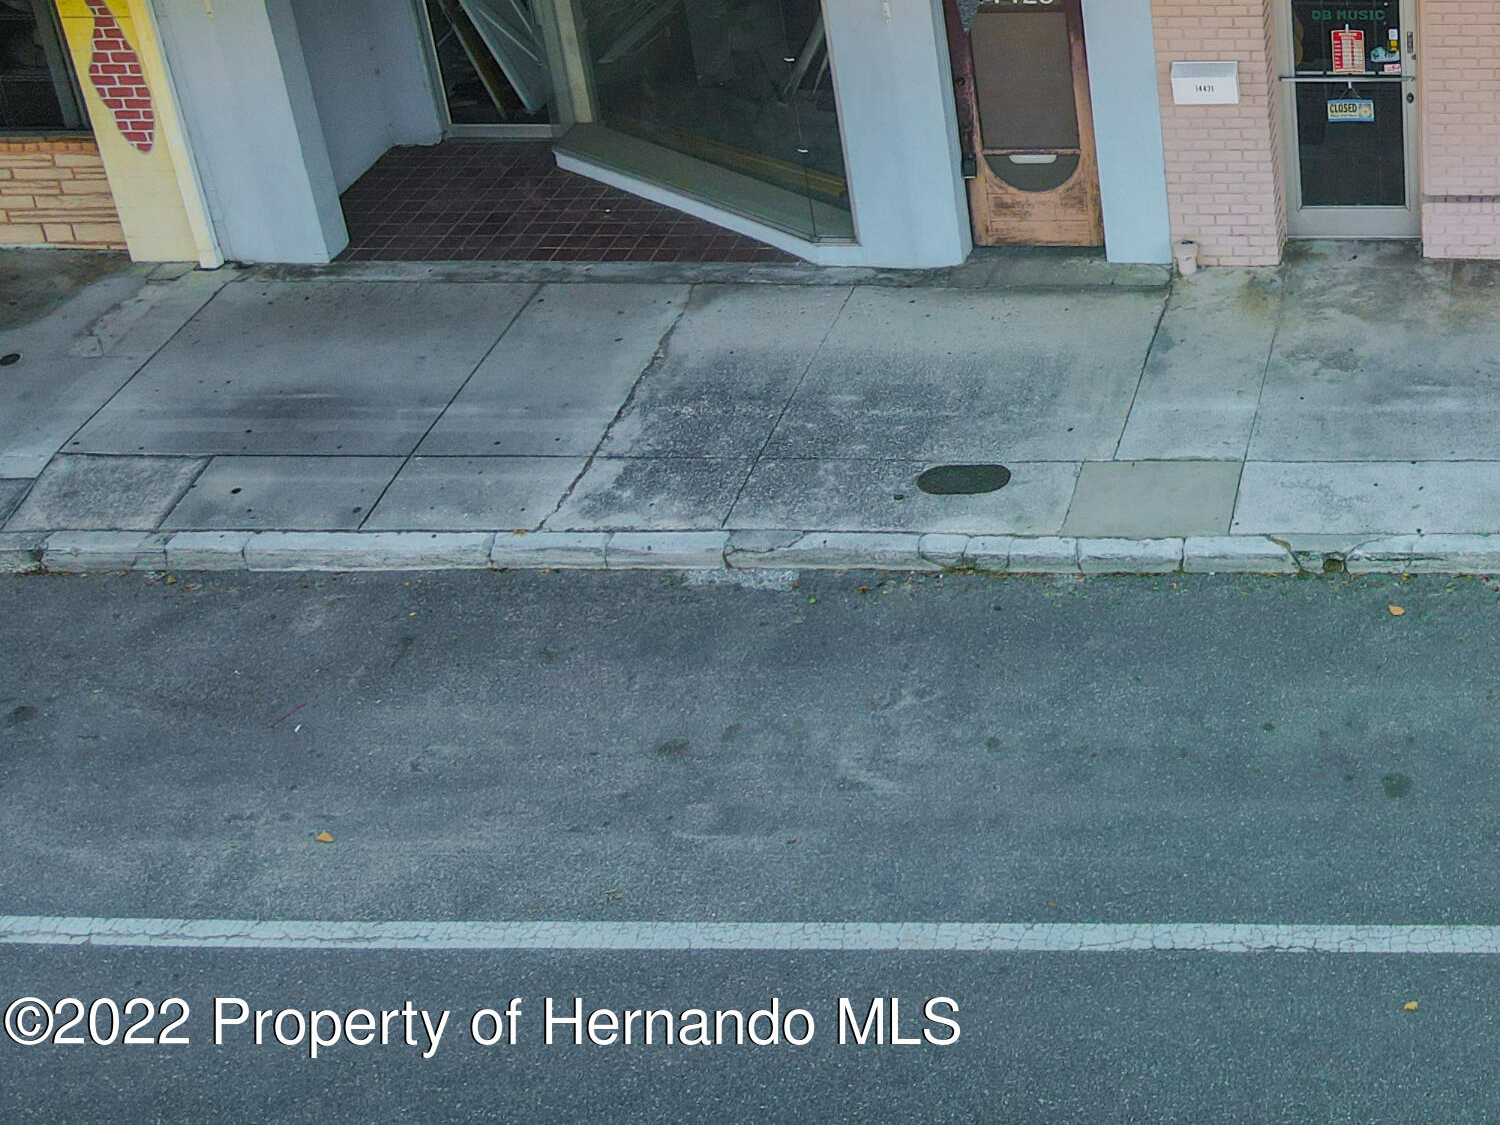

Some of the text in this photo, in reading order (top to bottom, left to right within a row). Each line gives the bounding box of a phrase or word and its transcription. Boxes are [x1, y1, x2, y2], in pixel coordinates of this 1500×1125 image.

[1310, 9, 1386, 21] DB MUSIC
[1329, 103, 1358, 114] CLOSED
